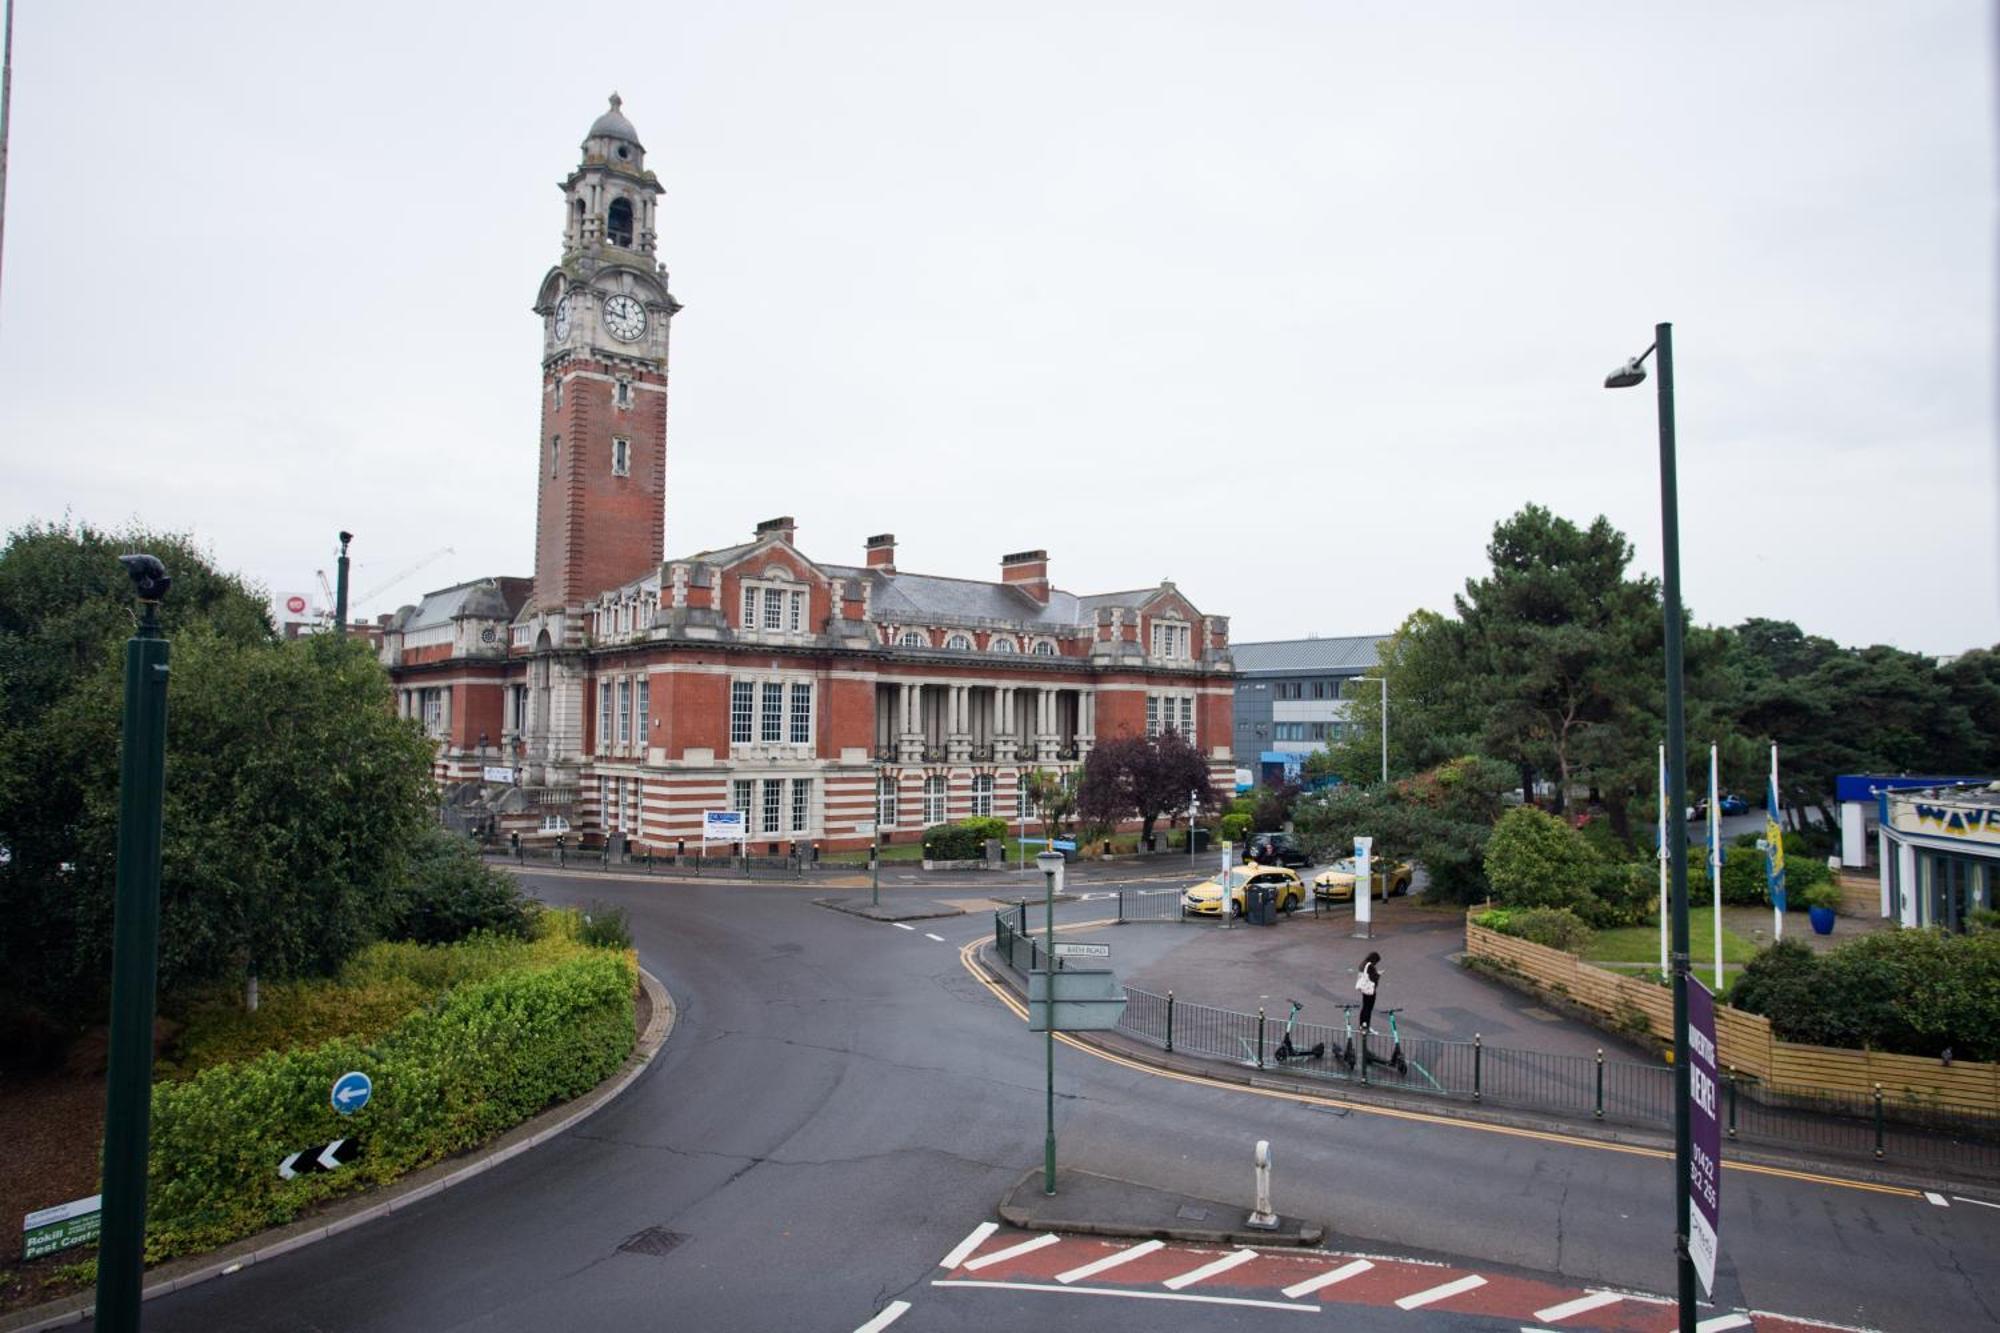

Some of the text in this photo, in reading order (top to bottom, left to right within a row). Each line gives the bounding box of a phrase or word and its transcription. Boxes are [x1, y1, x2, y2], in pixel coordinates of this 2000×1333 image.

[1067, 945, 1106, 955] BATH ROAD
[27, 1229, 63, 1247] Rokill
[26, 1242, 57, 1258] Pest
